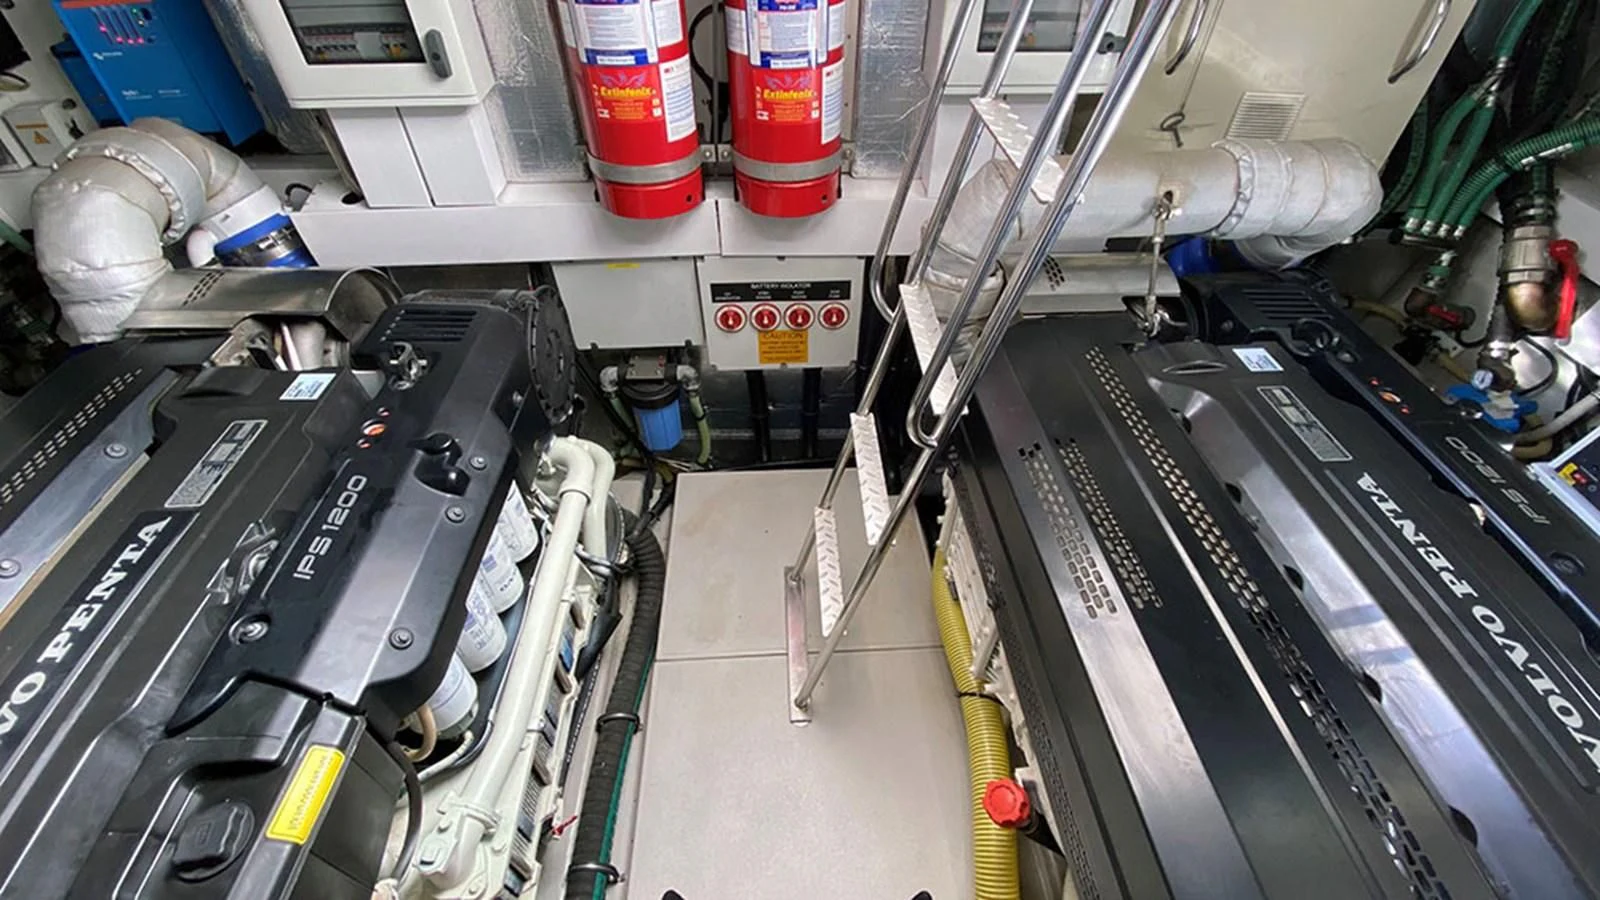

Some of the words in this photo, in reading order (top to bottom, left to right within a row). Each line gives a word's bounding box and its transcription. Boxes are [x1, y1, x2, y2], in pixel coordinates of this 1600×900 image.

[1445, 437, 1506, 484] 1200
[1500, 489, 1551, 524] IPS
[293, 536, 332, 579] IPS
[321, 475, 367, 531] 1200
[1357, 472, 1479, 598] PENTA
[37, 516, 172, 663] PENTA
